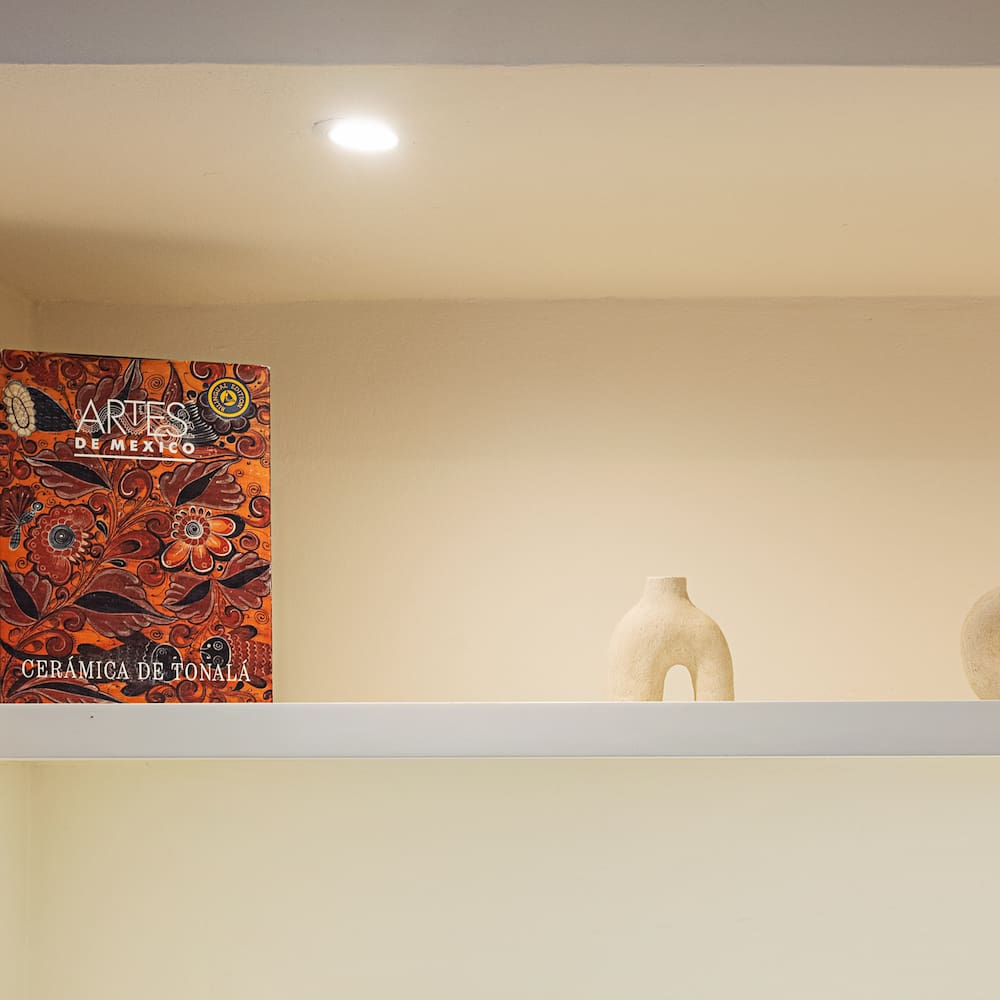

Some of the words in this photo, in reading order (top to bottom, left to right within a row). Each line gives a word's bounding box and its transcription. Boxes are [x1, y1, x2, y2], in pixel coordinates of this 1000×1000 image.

[213, 382, 228, 412] BILINGUAL
[230, 383, 245, 409] EDITION
[76, 399, 188, 438] ARTES
[75, 437, 100, 450] DE
[110, 439, 195, 455] MEXICO
[22, 656, 130, 680] CERÁMICA
[138, 662, 164, 680] DE
[171, 659, 251, 682] TONALÁ
